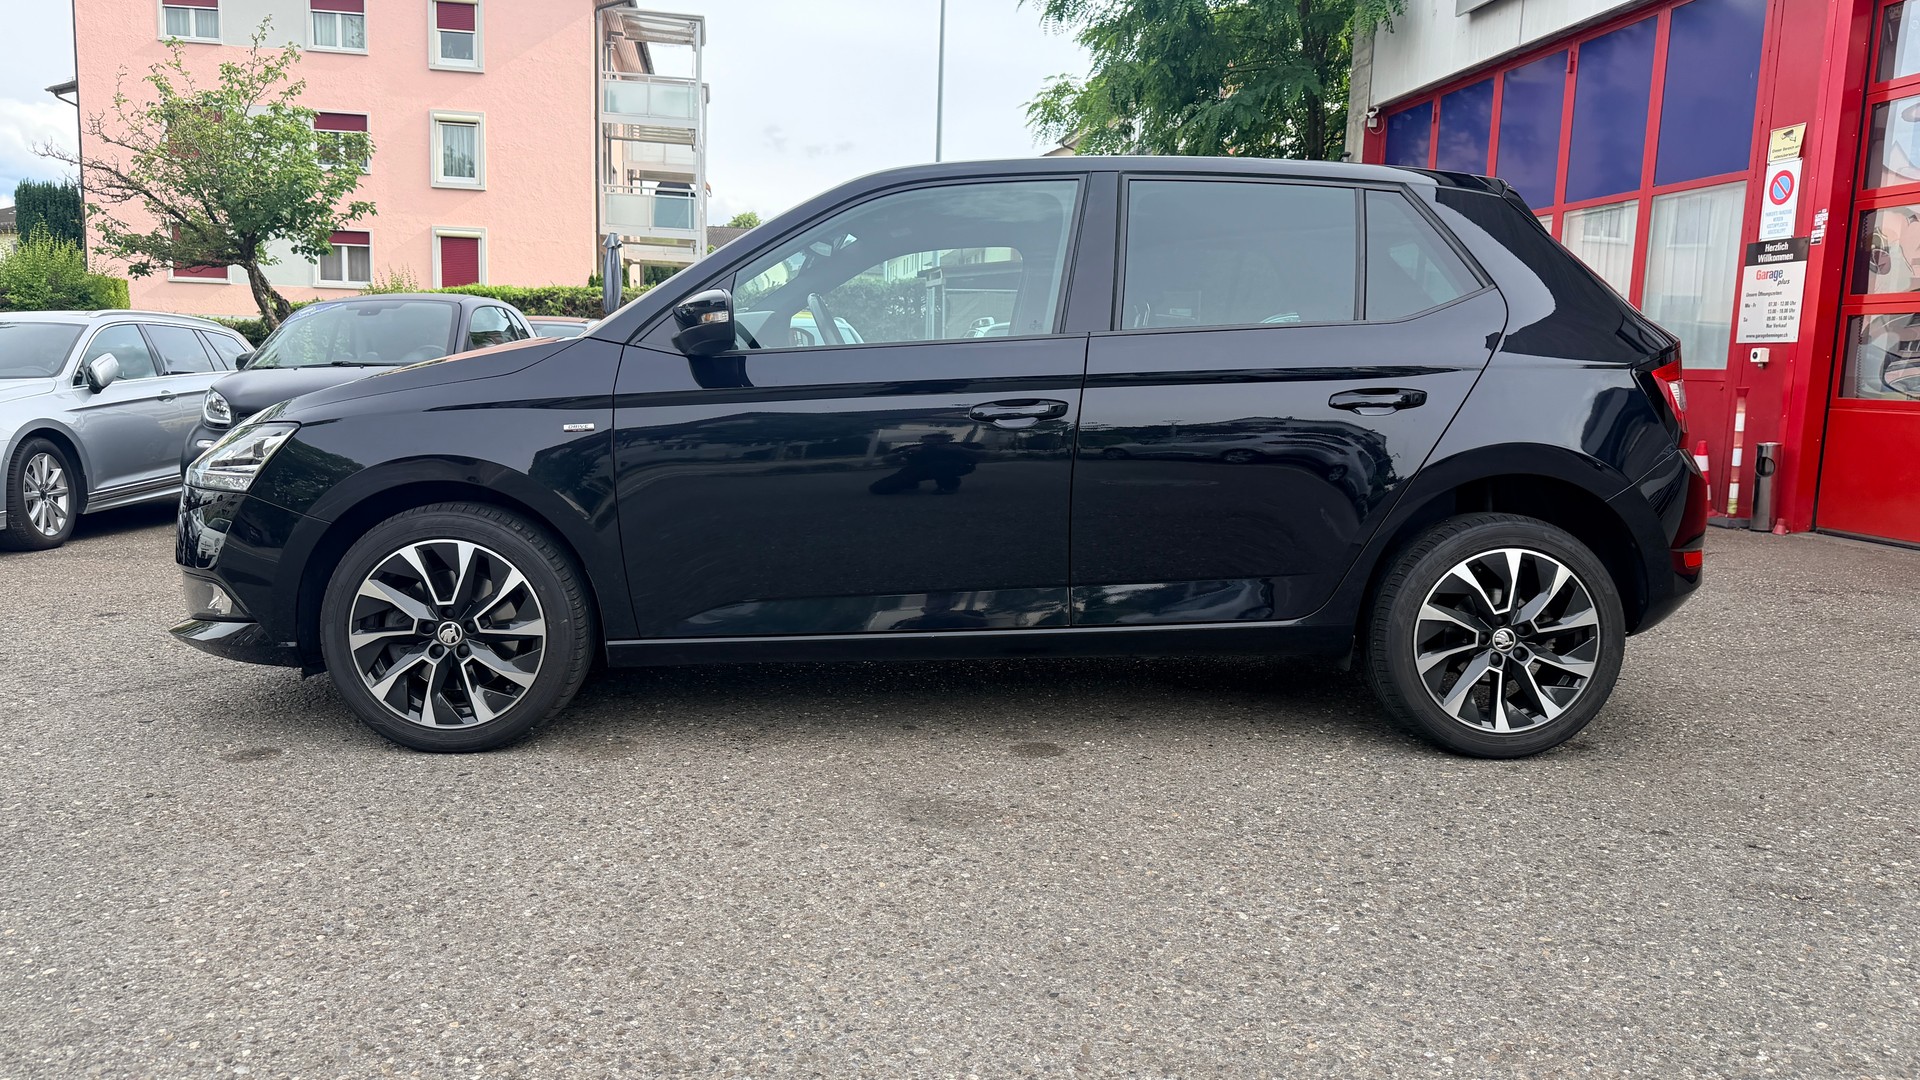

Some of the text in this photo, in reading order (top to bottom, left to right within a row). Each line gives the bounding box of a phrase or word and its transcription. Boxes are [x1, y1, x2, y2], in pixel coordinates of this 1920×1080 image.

[1764, 242, 1789, 252] Herzlich
[1757, 253, 1794, 263] Willkommen
[1756, 269, 1784, 281] Garage
